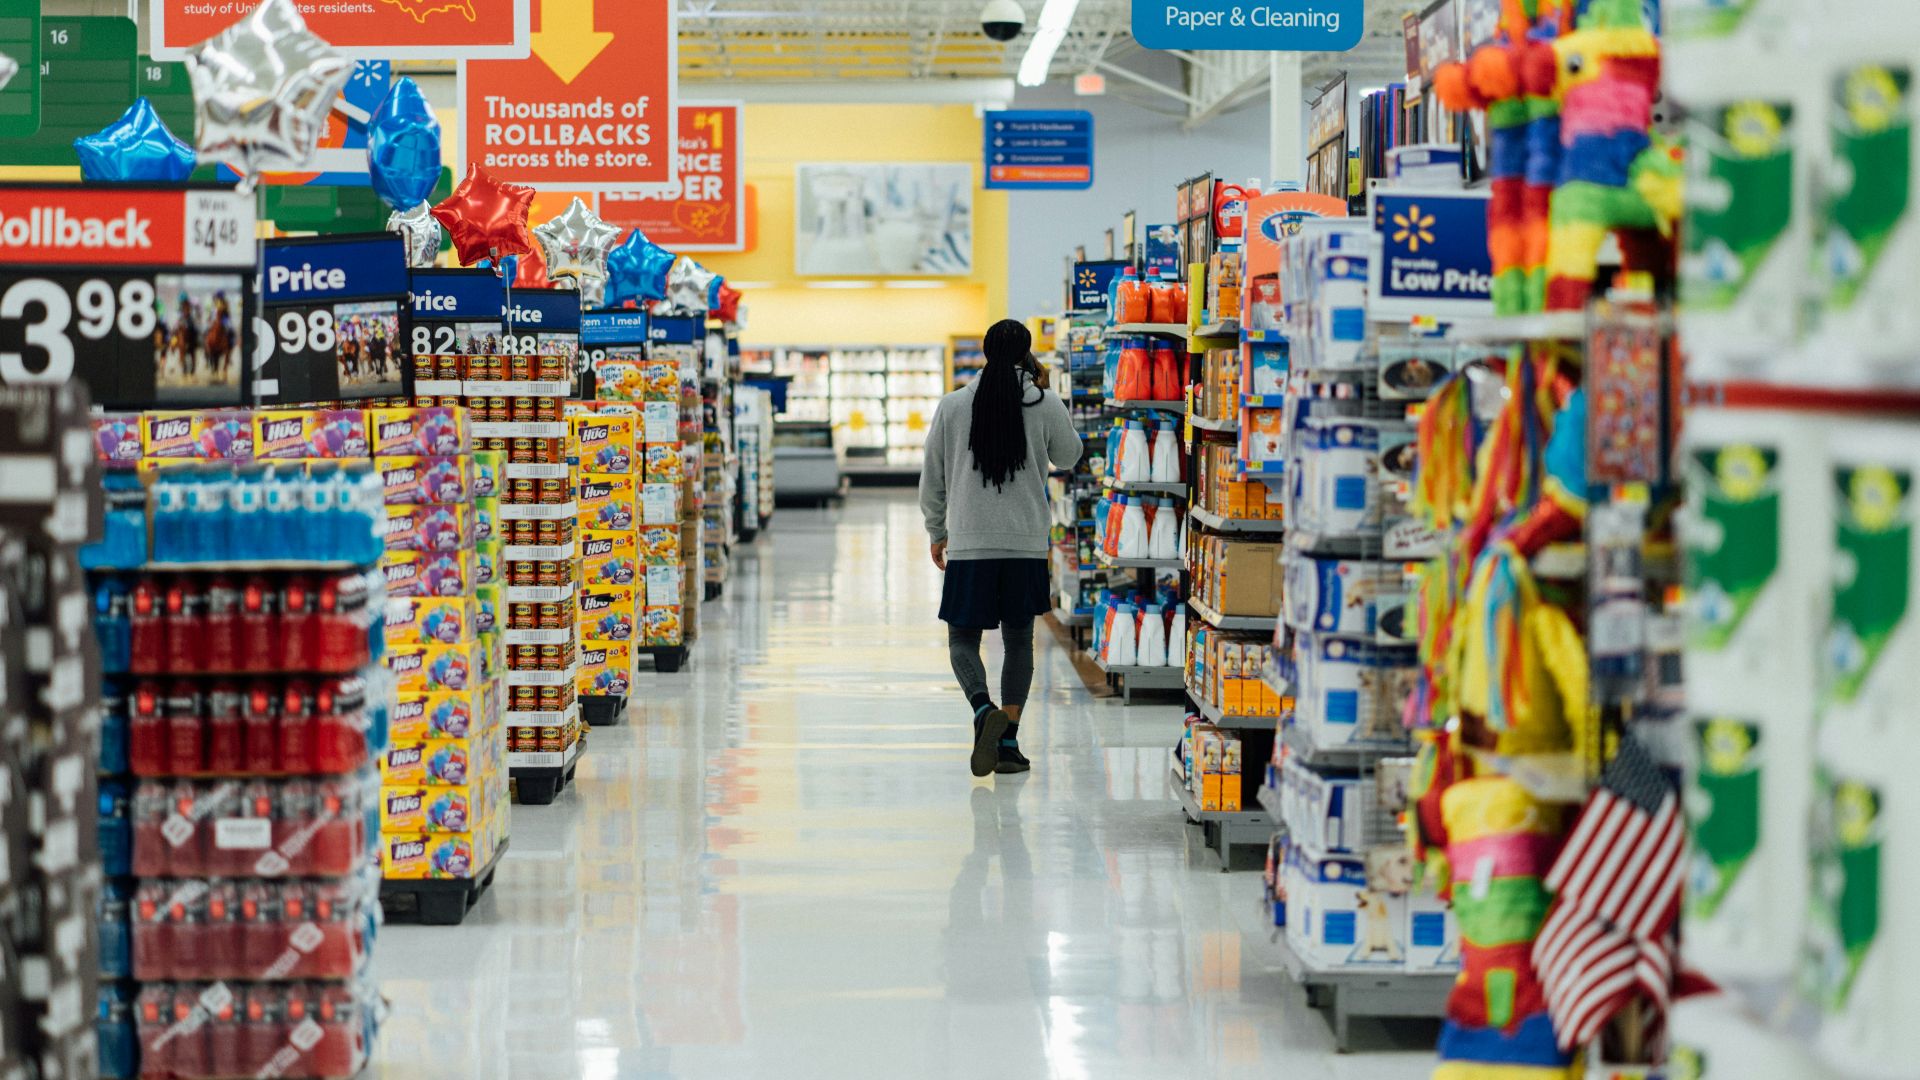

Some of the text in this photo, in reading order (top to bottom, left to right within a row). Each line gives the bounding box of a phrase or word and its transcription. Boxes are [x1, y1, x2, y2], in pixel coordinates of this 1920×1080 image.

[184, 3, 216, 16] study
[219, 2, 233, 13] of
[319, 2, 376, 13] residents.
[1166, 7, 1340, 32] Paper & Cleaning
[50, 29, 69, 45] 16
[145, 66, 162, 81] 18
[484, 96, 649, 119] Thousands of
[485, 124, 651, 146] ROLLBACKS
[693, 111, 723, 149] #1
[484, 148, 652, 167] across the store.
[678, 153, 722, 172] RICE
[0, 207, 152, 248] ollback
[269, 263, 346, 292] Price
[1391, 269, 1441, 290] Low
[617, 316, 641, 325] meal
[411, 326, 456, 355] 82
[582, 429, 607, 442] HUG
[586, 541, 611, 555] HUG
